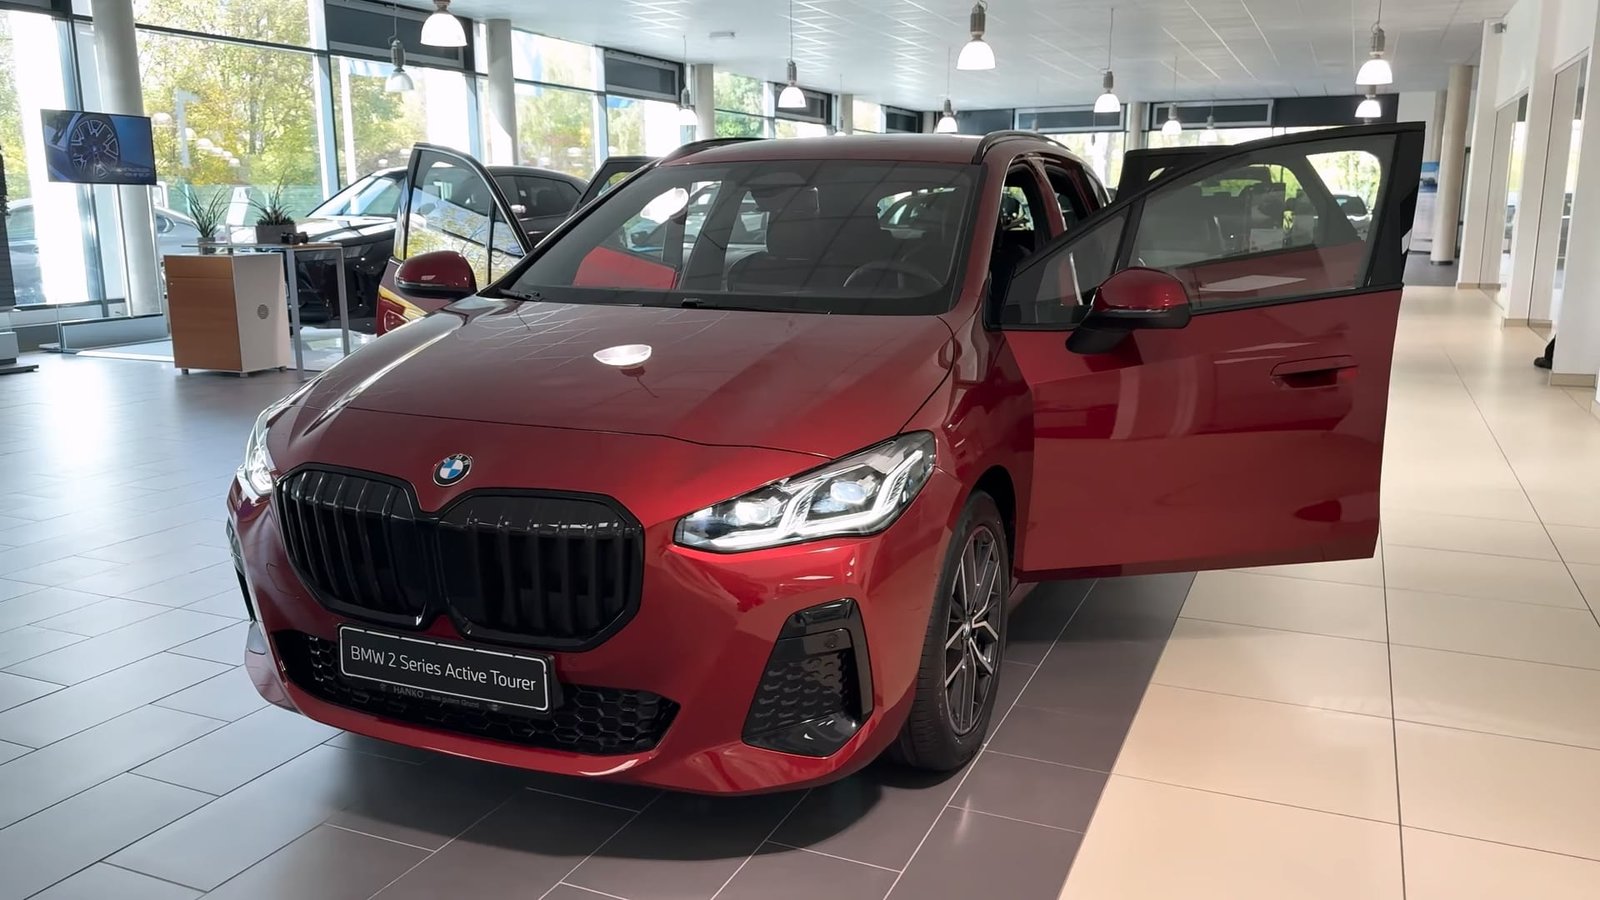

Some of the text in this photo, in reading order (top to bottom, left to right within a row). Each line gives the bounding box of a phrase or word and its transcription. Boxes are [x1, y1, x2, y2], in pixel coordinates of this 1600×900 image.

[350, 645, 536, 691] BMW 2 Series Active Tourer
[393, 686, 424, 698] HANKO
